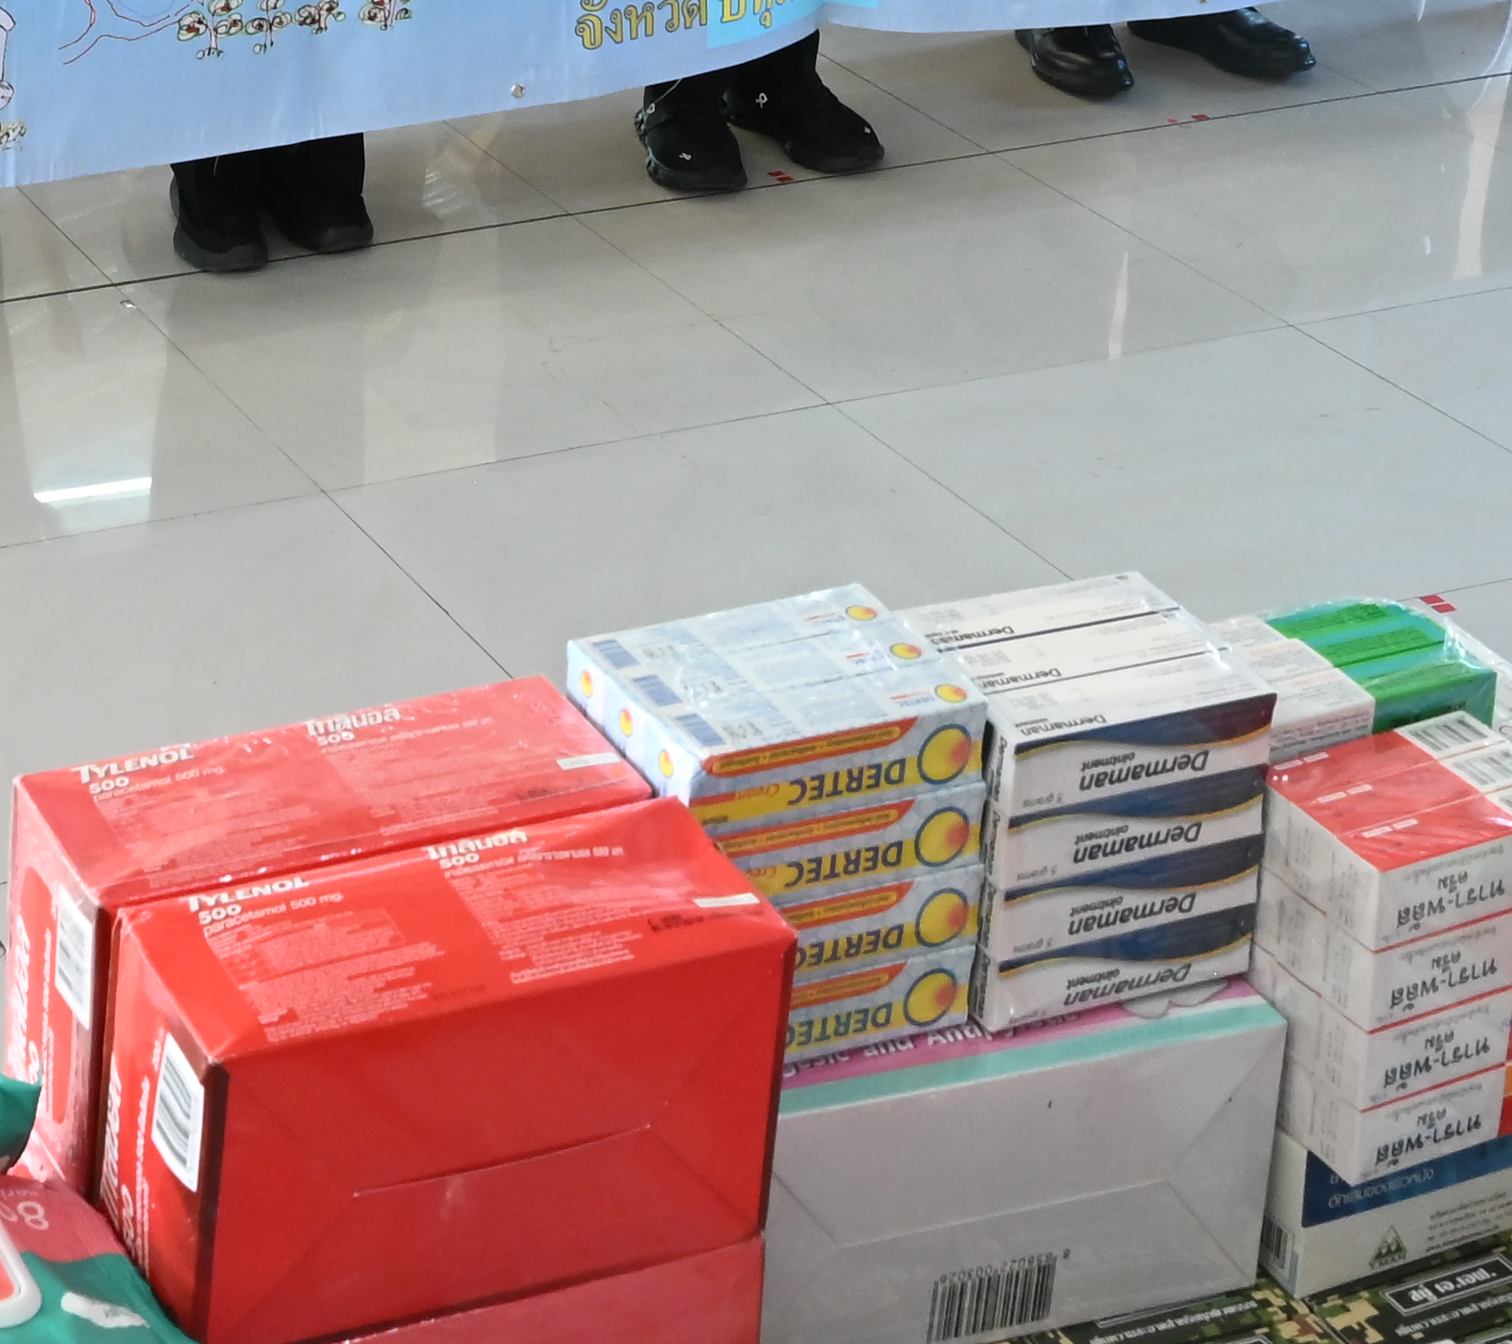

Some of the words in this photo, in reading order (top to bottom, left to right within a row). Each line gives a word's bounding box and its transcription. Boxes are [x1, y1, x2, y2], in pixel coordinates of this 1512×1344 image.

[1020, 714, 1106, 737] Dermaman
[71, 747, 195, 784] TYLENOL
[1079, 750, 1209, 791] Dermaman
[1081, 752, 1136, 772] ointment
[89, 776, 130, 795] 500
[787, 758, 906, 806] DERTEC
[1073, 822, 1202, 864] Dermaman
[1074, 825, 1129, 845] ointment
[439, 852, 480, 869] 500
[786, 840, 904, 888] DERTEC
[188, 876, 310, 913] TYLENOL
[1437, 870, 1469, 894] ครีม
[198, 903, 242, 925] 500
[203, 903, 286, 938] paracetamol
[290, 895, 316, 911] 500
[1068, 892, 1197, 936] Dermaman
[1069, 895, 1124, 917] ointment
[1395, 878, 1506, 932] ทารา-พลัส
[1066, 968, 1120, 990] ointment
[1431, 949, 1462, 973] ครีม
[1063, 963, 1192, 1006] Dermaman
[1389, 957, 1498, 1012] ทารา-พลัส
[1425, 1029, 1455, 1053] ครีม
[1382, 1037, 1490, 1091] ทารา-พลัส
[1417, 1107, 1447, 1131] ครีม
[1375, 1113, 1482, 1168] ทารา-พลัส
